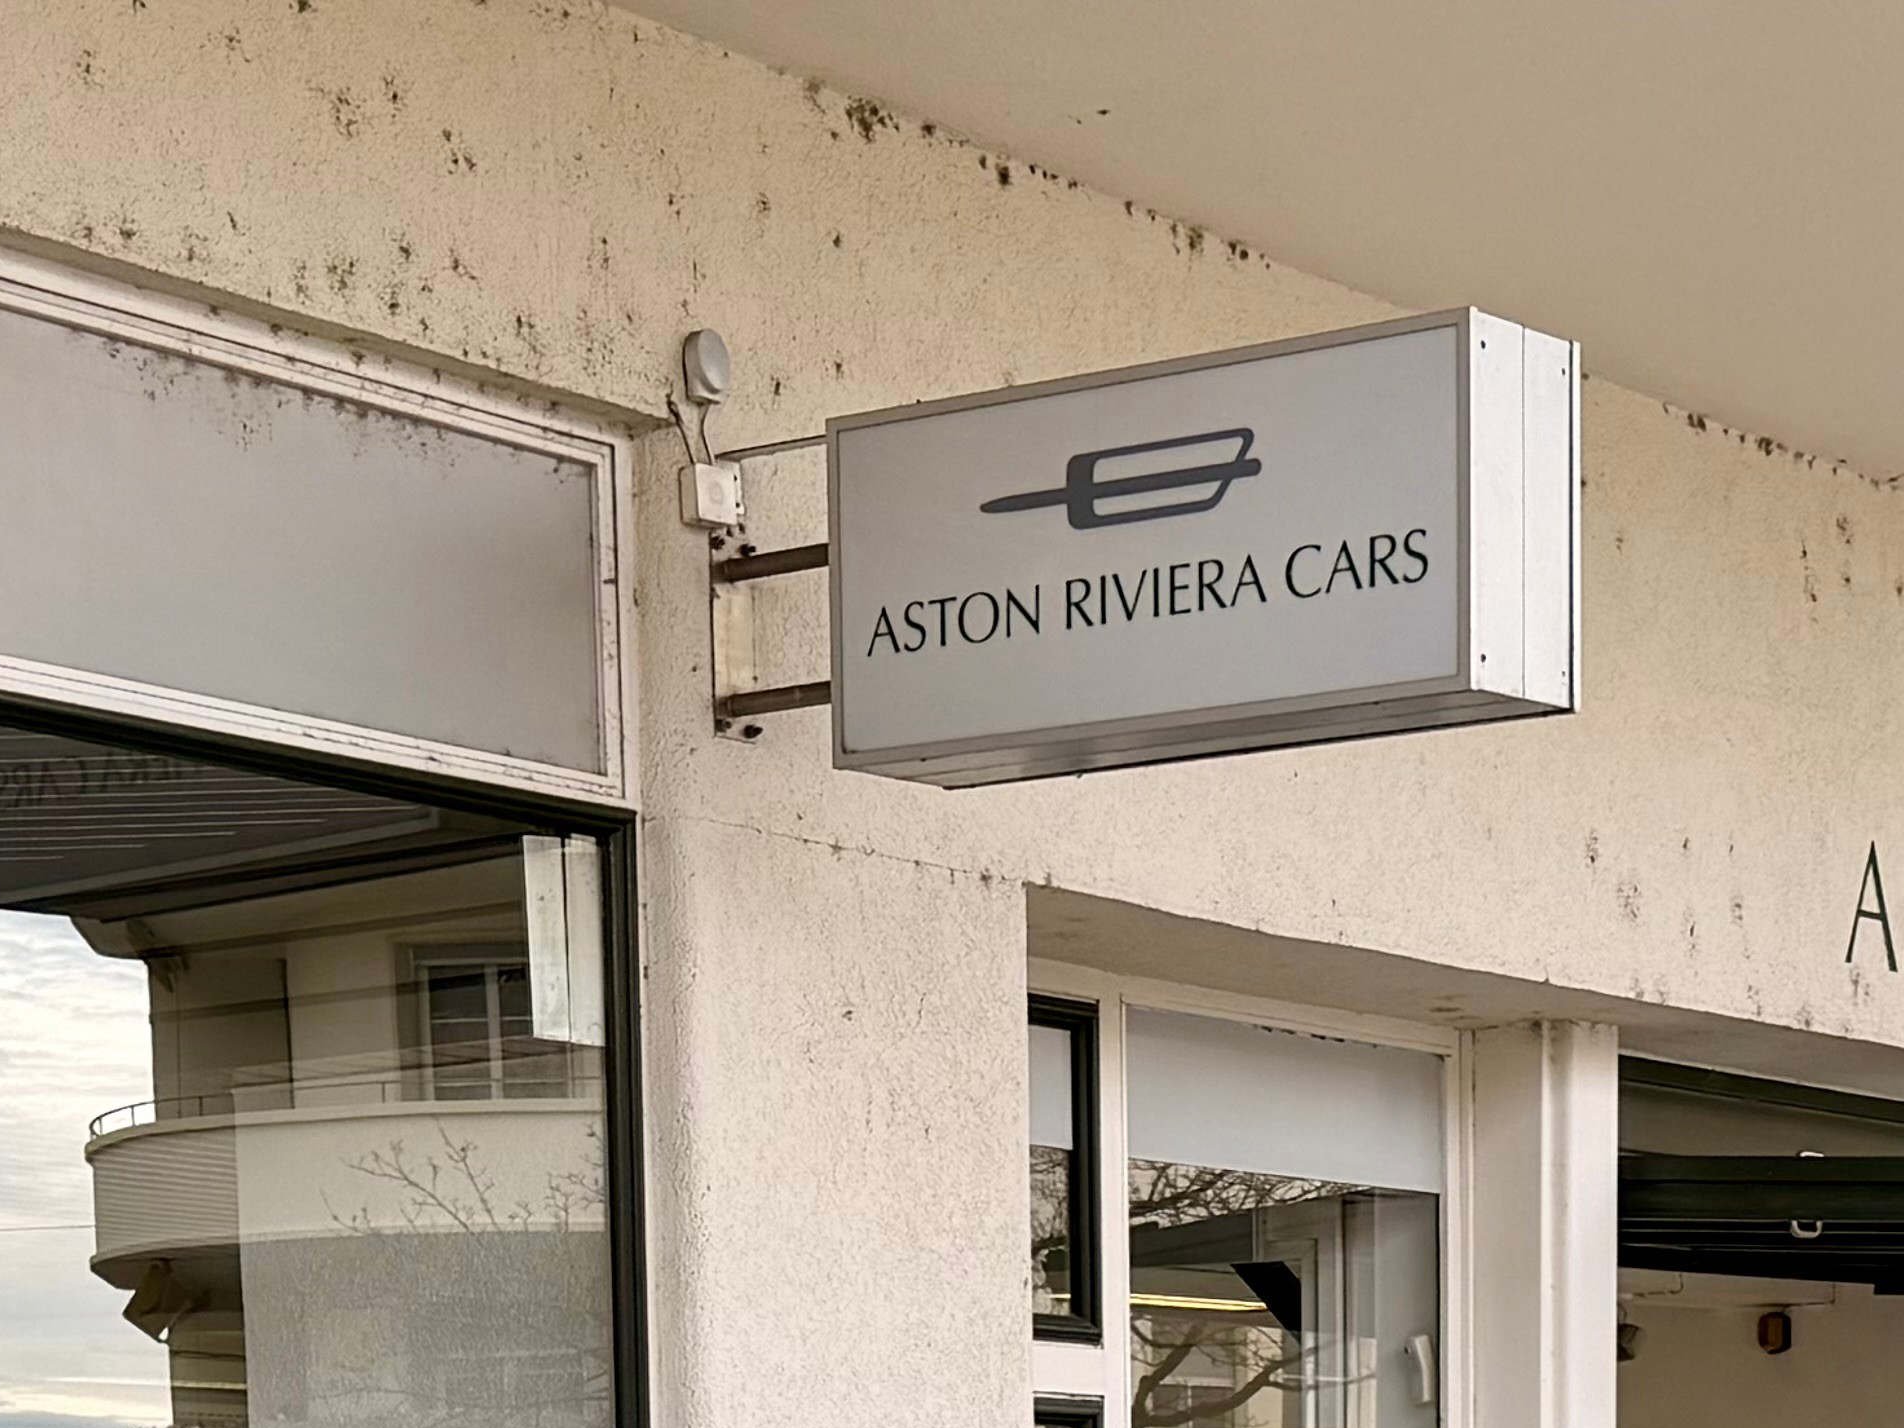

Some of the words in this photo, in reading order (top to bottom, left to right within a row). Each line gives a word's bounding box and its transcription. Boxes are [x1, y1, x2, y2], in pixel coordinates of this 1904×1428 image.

[867, 584, 1041, 658] ASTON
[1064, 553, 1267, 633] RIVIERA
[1286, 527, 1430, 600] CARS
